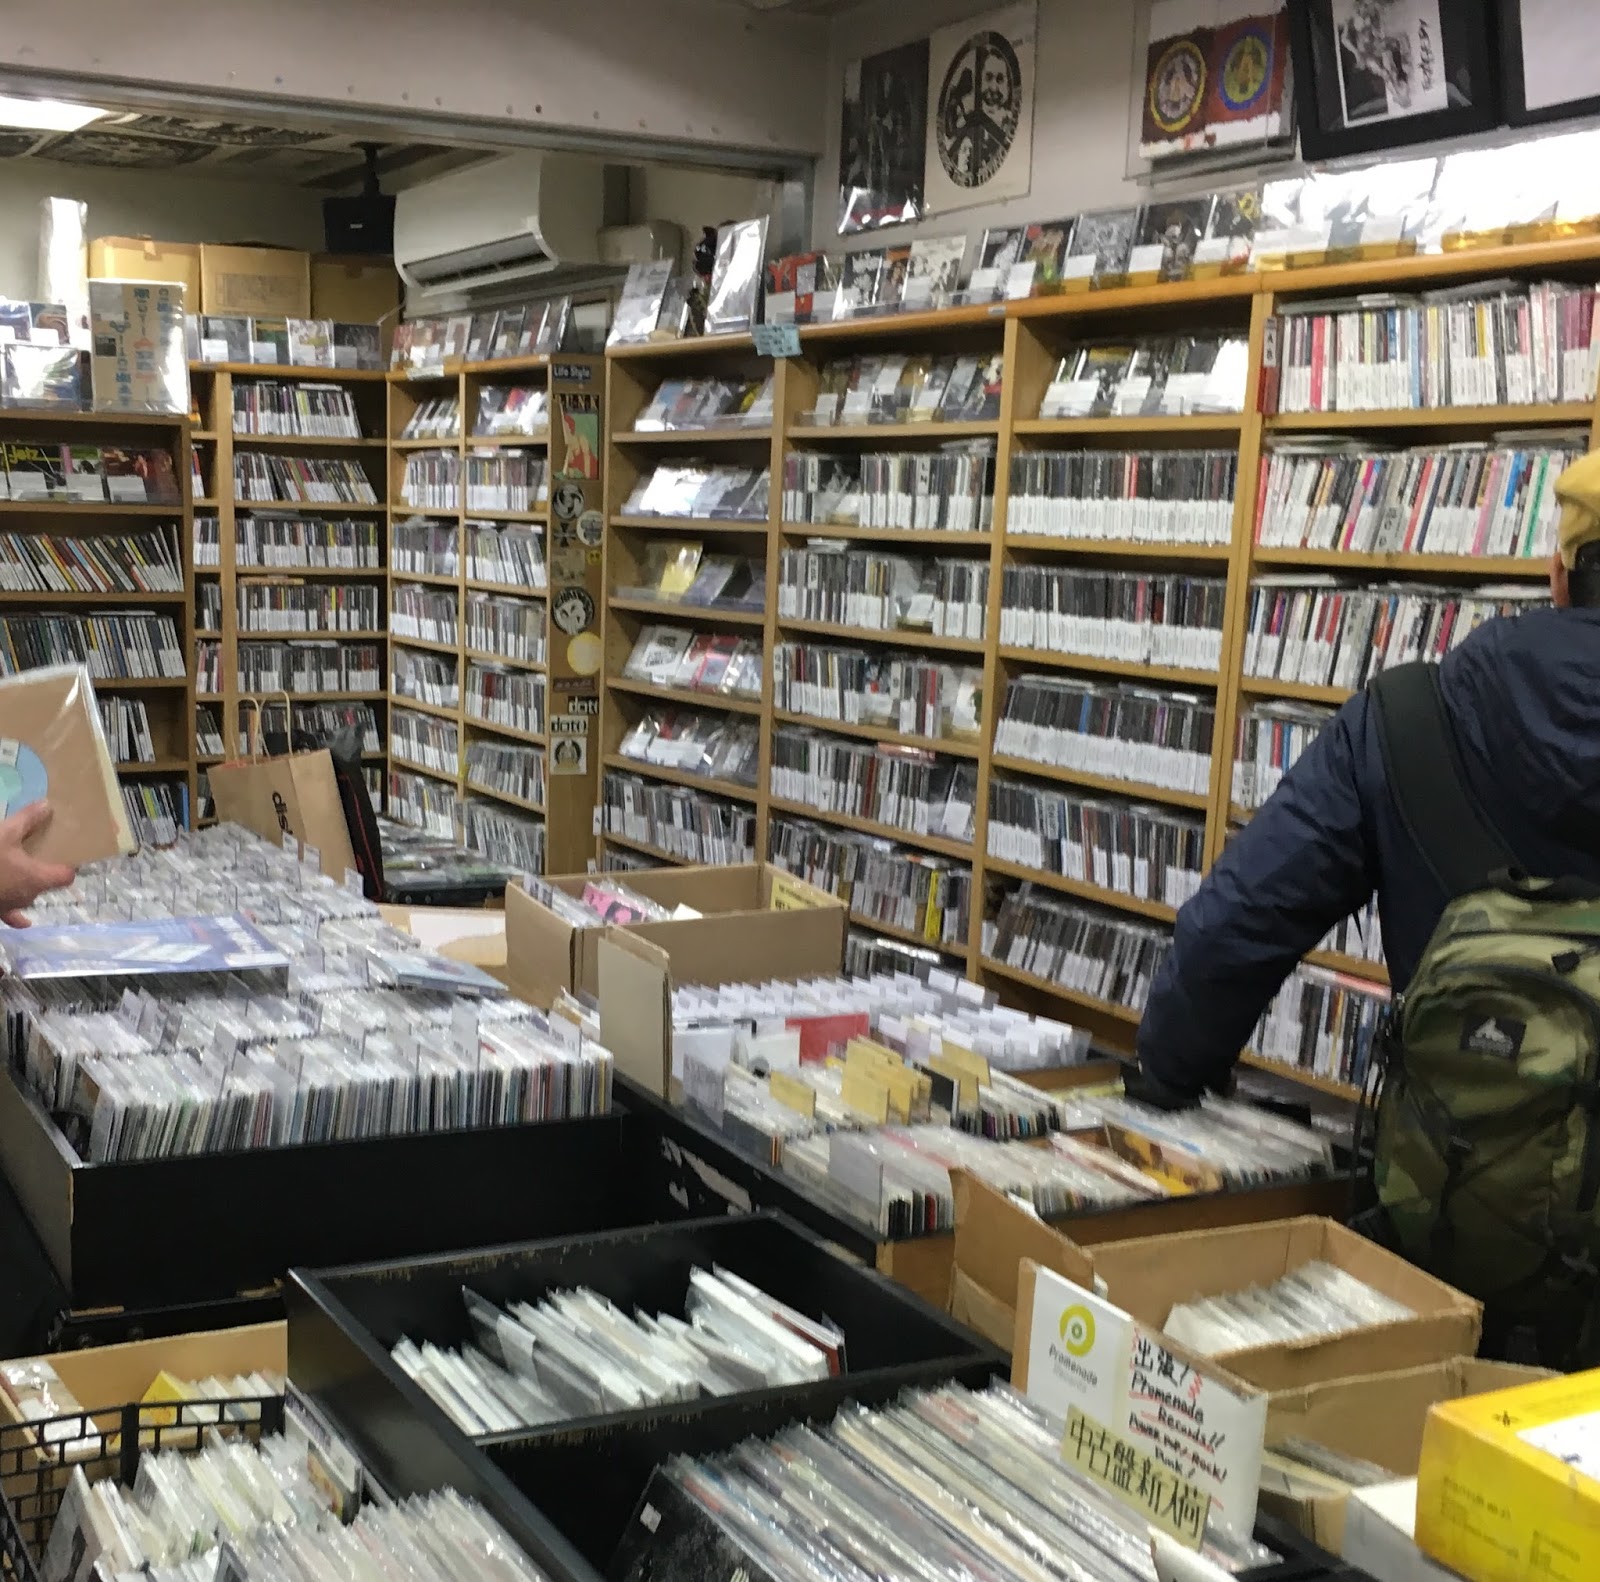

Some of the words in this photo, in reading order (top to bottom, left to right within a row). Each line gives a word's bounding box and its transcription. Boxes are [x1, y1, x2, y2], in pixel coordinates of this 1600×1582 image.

[1070, 1414, 1201, 1539] 中古盤新入荷
